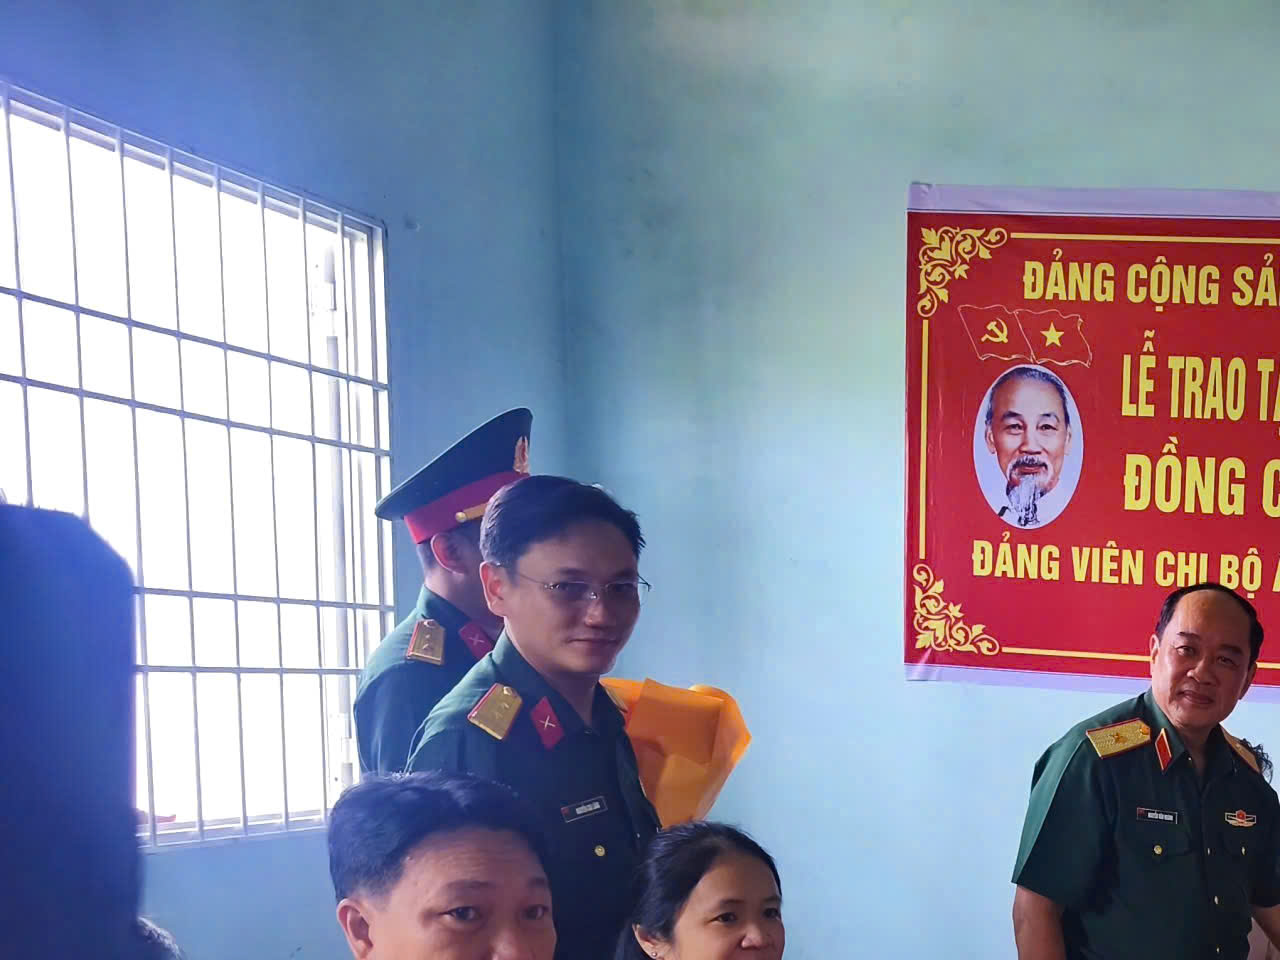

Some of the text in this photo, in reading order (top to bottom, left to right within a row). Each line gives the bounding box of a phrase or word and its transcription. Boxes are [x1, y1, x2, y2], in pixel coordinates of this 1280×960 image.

[1023, 248, 1114, 301] ĐẢNG
[1127, 256, 1219, 311] CỘNG
[1122, 330, 1156, 416] LỄ
[1168, 356, 1246, 421] TRAO
[1124, 437, 1245, 515] ĐỒNG
[972, 531, 1059, 580] ĐẢNG
[1072, 541, 1143, 585] VIÊN
[1156, 551, 1208, 587] CHI
[1220, 548, 1262, 598] BỘ
